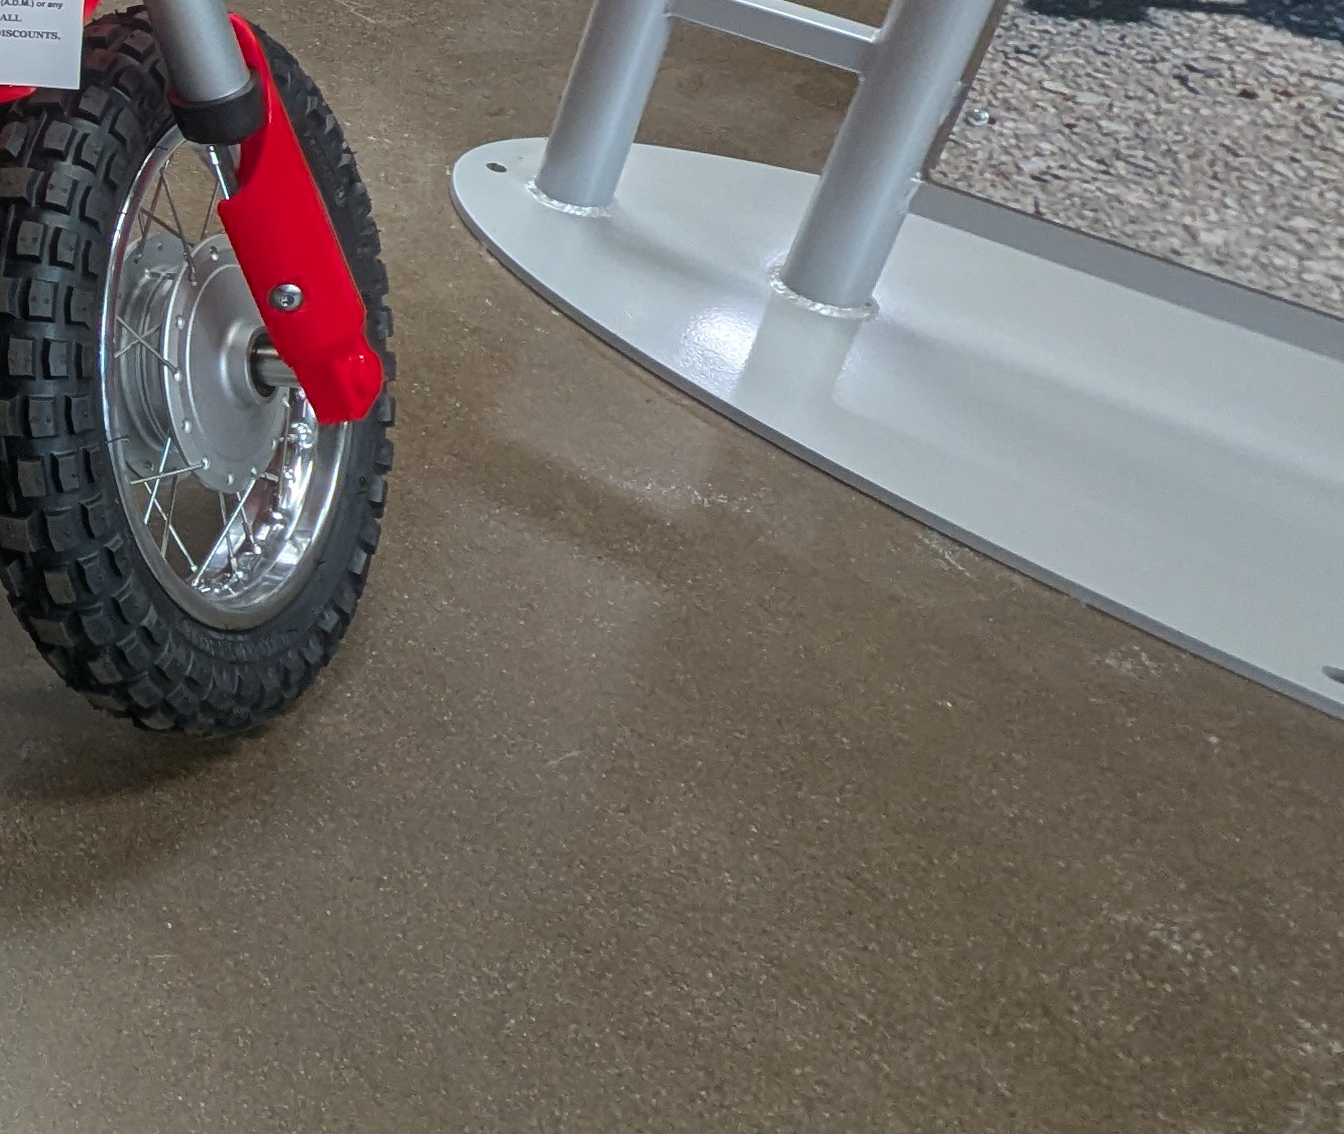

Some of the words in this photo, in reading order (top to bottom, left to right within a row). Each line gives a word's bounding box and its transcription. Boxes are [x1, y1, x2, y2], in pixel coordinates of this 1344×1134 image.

[1, 0, 34, 8] (A.D.M.)
[48, 1, 63, 9] any
[0, 13, 23, 22] ALL
